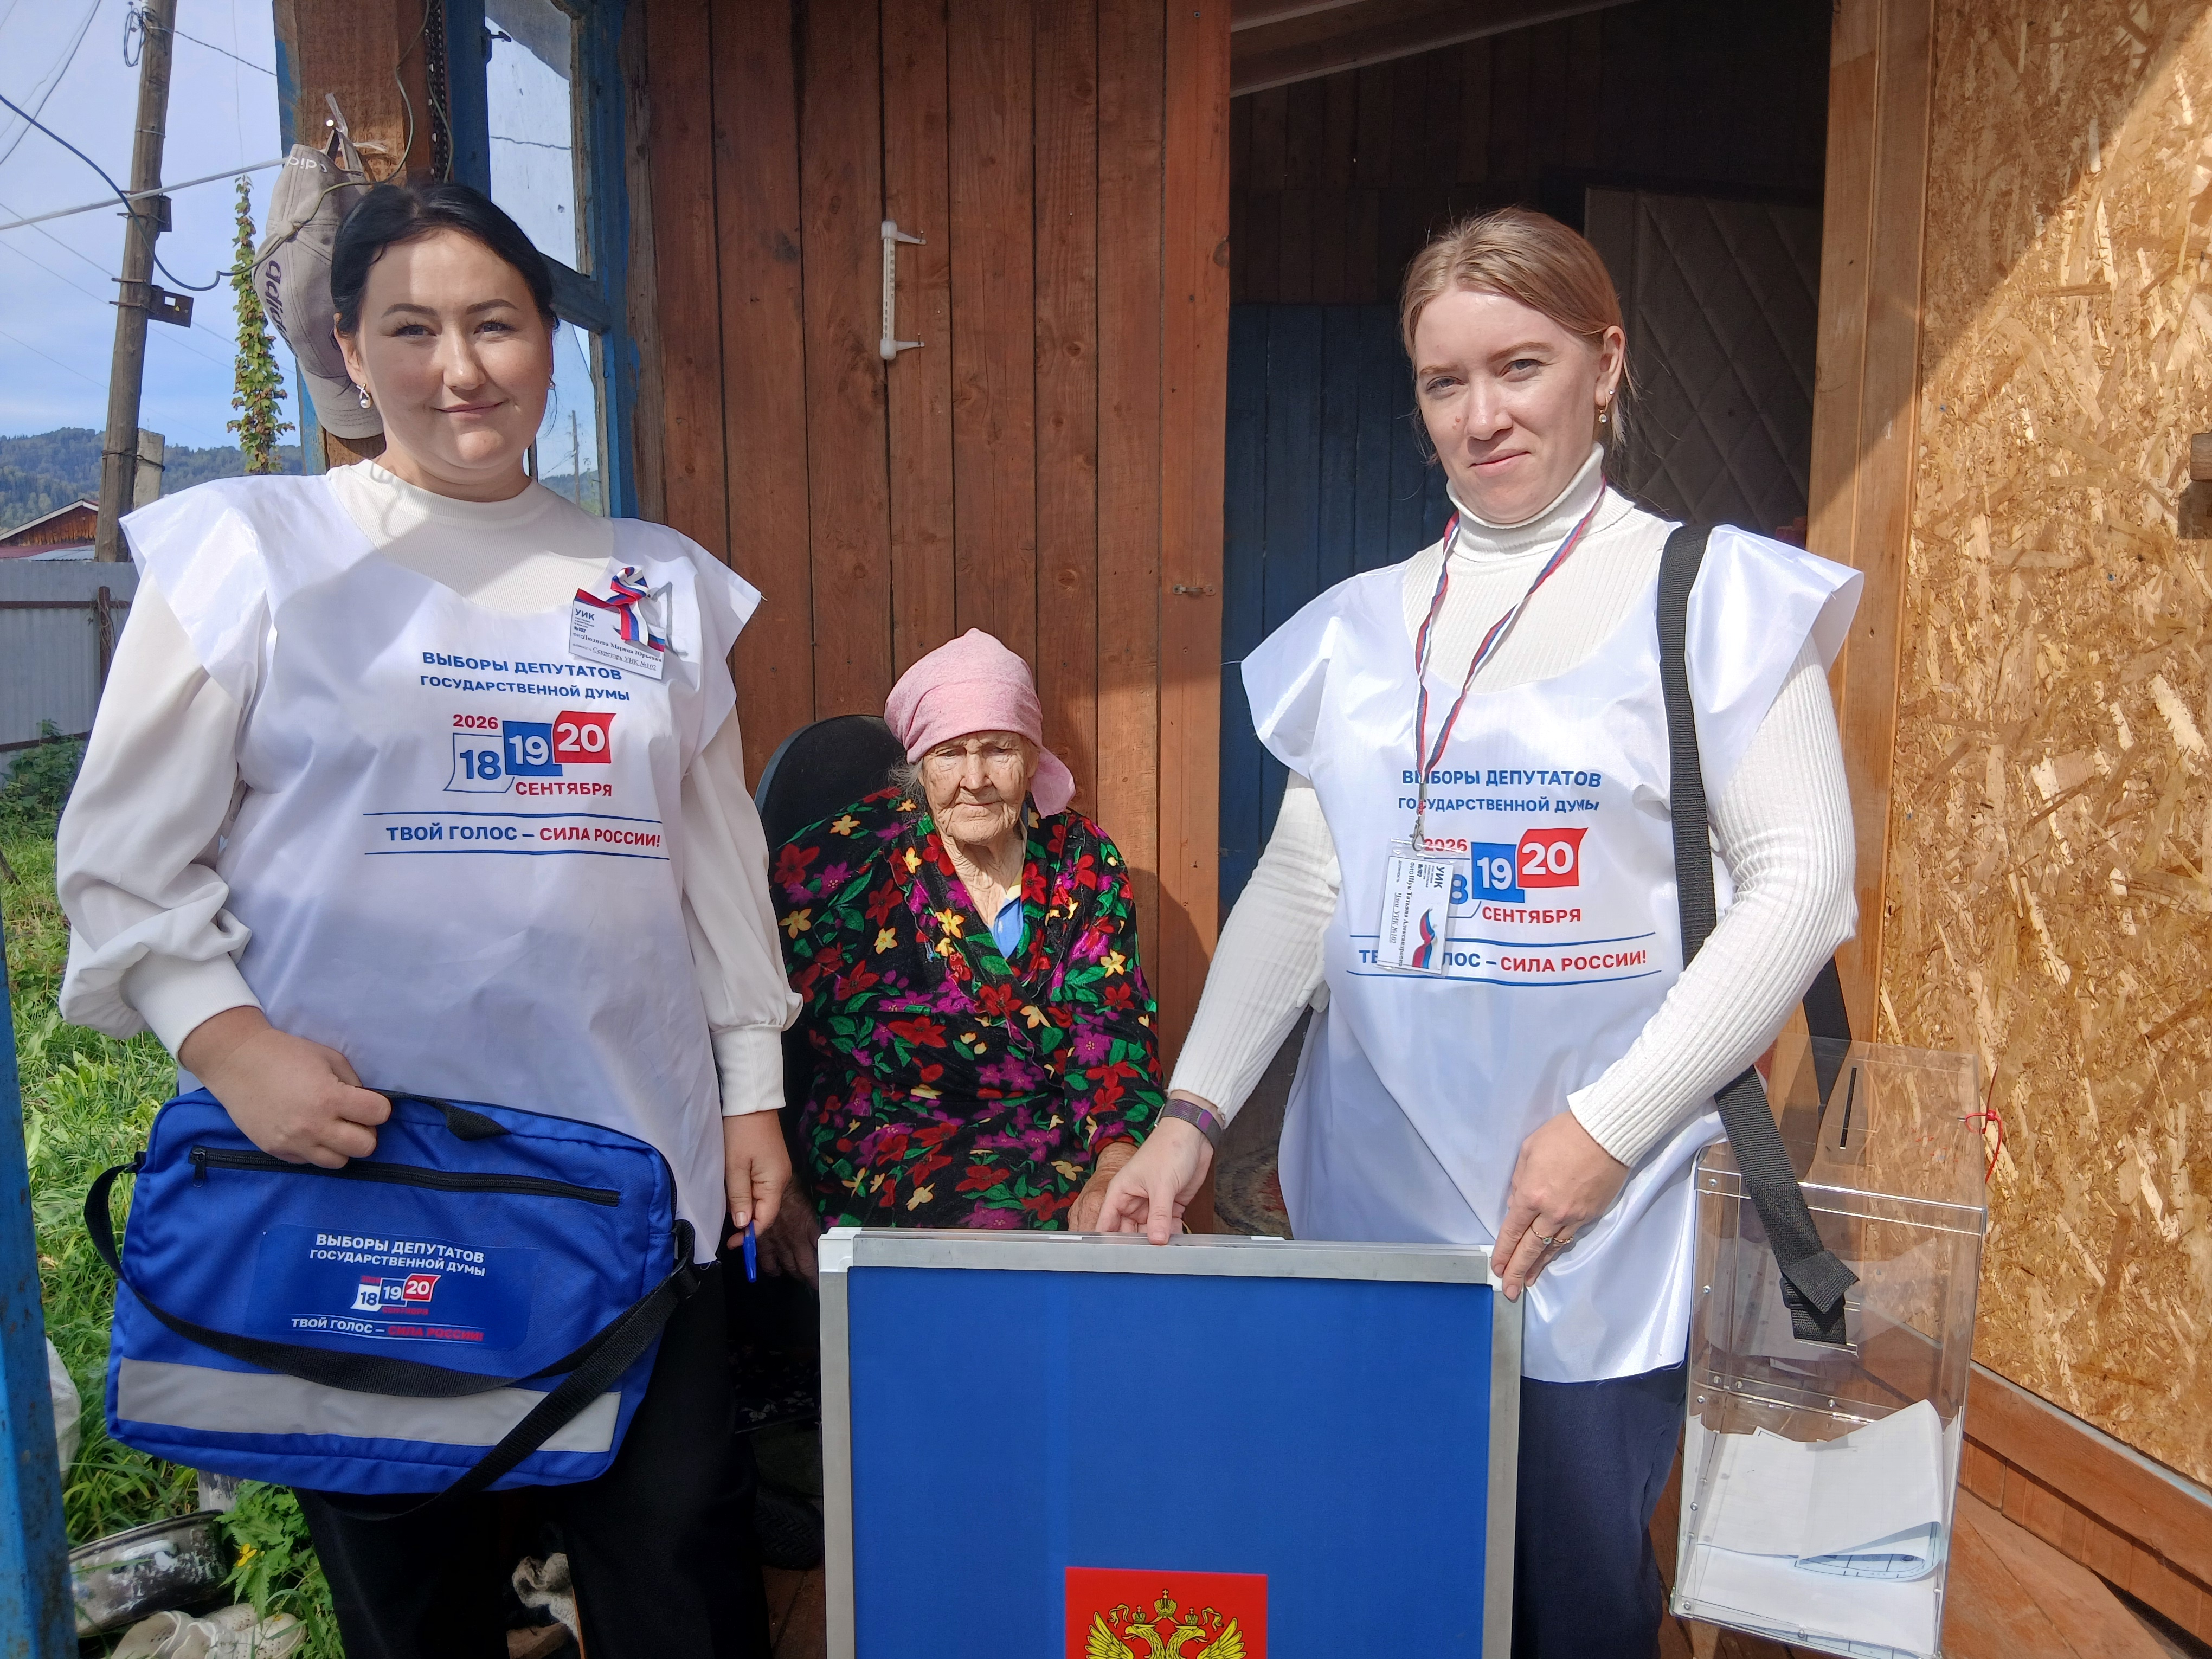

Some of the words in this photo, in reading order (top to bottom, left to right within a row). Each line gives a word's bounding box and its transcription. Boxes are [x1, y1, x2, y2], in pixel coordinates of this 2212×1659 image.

[575, 608, 595, 621] УИК
[422, 651, 509, 672] ВЫБОРЫ
[514, 661, 622, 680] ДЕПУТАТОВ
[623, 656, 639, 666] УИК
[420, 675, 581, 697] ГОСУДАРСТВЕННОЙ
[585, 687, 630, 701] ДУМЫ
[453, 714, 498, 730] 2026
[460, 750, 501, 780] 18
[509, 735, 549, 766] 19
[557, 723, 605, 753] 20
[516, 782, 612, 797] СЕНТЯБРЯ
[1486, 770, 1602, 787] ДЕПУТАТОВ
[1554, 799, 1600, 813] ДУМЫ
[386, 822, 443, 841] ТВОЙ
[449, 826, 517, 840] ГОЛОС
[539, 827, 590, 841] СИЛА
[594, 828, 660, 847] РОССИИ!
[1424, 839, 1467, 852] 2026
[1433, 866, 1445, 889] УИК
[1449, 874, 1468, 905] 8
[1477, 857, 1512, 890] 19
[1521, 841, 1574, 874] 20
[1392, 910, 1400, 924] УИК
[1482, 906, 1581, 924] СЕНТЯБРЯ
[1442, 952, 1480, 967] ЛОС
[1500, 956, 1554, 972] СИЛА
[1561, 950, 1647, 971] РОССИИ!
[316, 1233, 389, 1252] ВЫБОРЫ
[391, 1241, 485, 1264] ДЕПУТАТОВ
[310, 1249, 445, 1270] ГОСУДАРСТВЕННОЙ
[446, 1263, 486, 1277] ДУМЫ
[361, 1291, 377, 1306] 18
[383, 1285, 402, 1300] 19
[406, 1280, 430, 1295] 20
[291, 1316, 327, 1329] ТВОЙ
[330, 1319, 373, 1334] ГОЛОС
[388, 1326, 423, 1336] СИЛА
[427, 1327, 484, 1342] РОССИИ!
